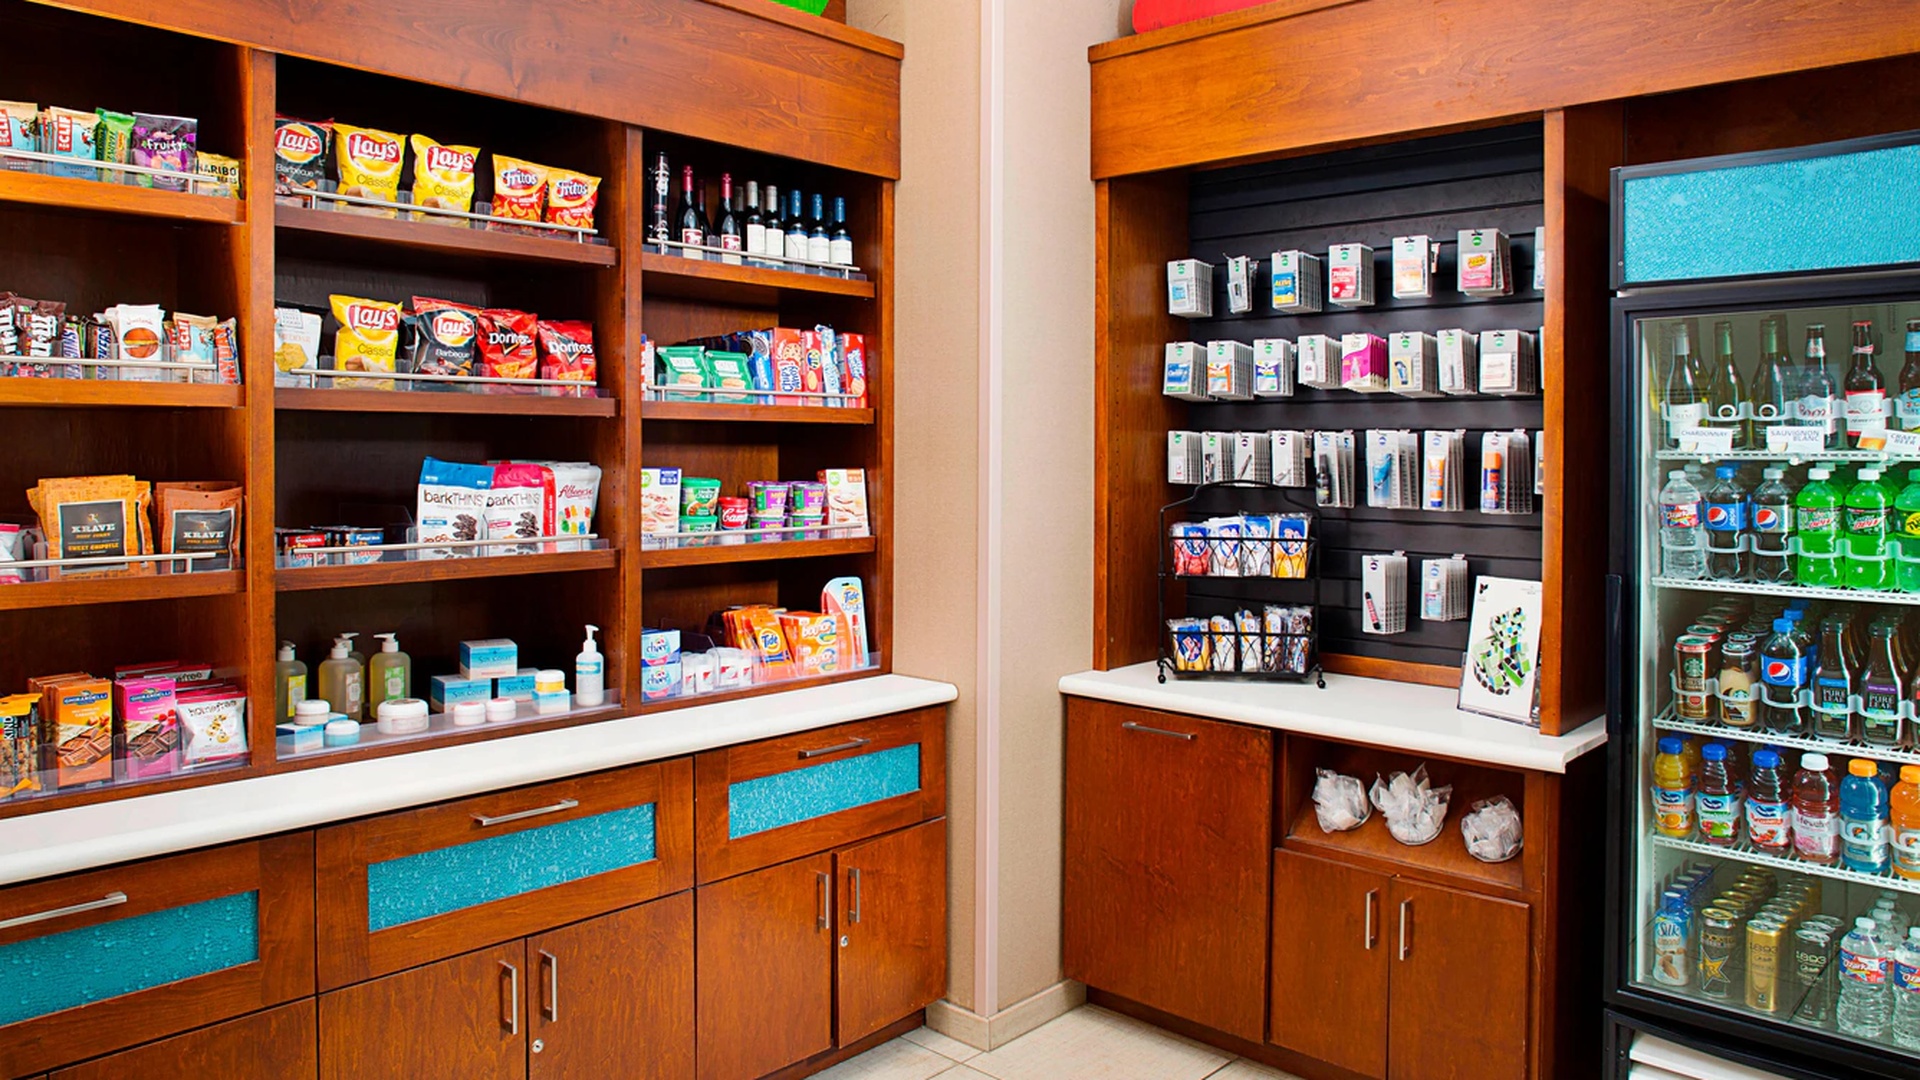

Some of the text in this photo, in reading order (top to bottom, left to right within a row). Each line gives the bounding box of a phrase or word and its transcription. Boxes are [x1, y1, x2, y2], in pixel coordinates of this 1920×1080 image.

[58, 115, 72, 141] CLIF
[277, 129, 318, 153] Lay's
[352, 134, 398, 160] Lay's
[430, 147, 474, 172] Lay's
[356, 173, 393, 189] Classic
[501, 167, 538, 187] Fritos
[433, 184, 470, 199] Classic
[556, 179, 588, 198] Fritos
[353, 306, 396, 329] Lay's
[436, 320, 471, 336] Lay's
[489, 332, 532, 345] Doritos
[357, 343, 393, 356] Classic
[435, 348, 470, 359] Barbecue
[548, 342, 593, 354] Doritos
[1681, 429, 1728, 437] CHARDONNAY
[423, 489, 484, 506] barkTHINS
[1729, 507, 1737, 527] pepsi
[71, 523, 115, 533] KRAVE
[183, 531, 224, 539] KRAVE
[90, 542, 119, 550] CHIPOTLE
[844, 590, 859, 603] Tide
[761, 634, 778, 648] Tide
[1822, 688, 1845, 697] PURE
[1869, 695, 1894, 703] PURE
[4, 715, 13, 739] KIND
[1659, 921, 1680, 937] Silk
[1795, 950, 1826, 964] 1893
